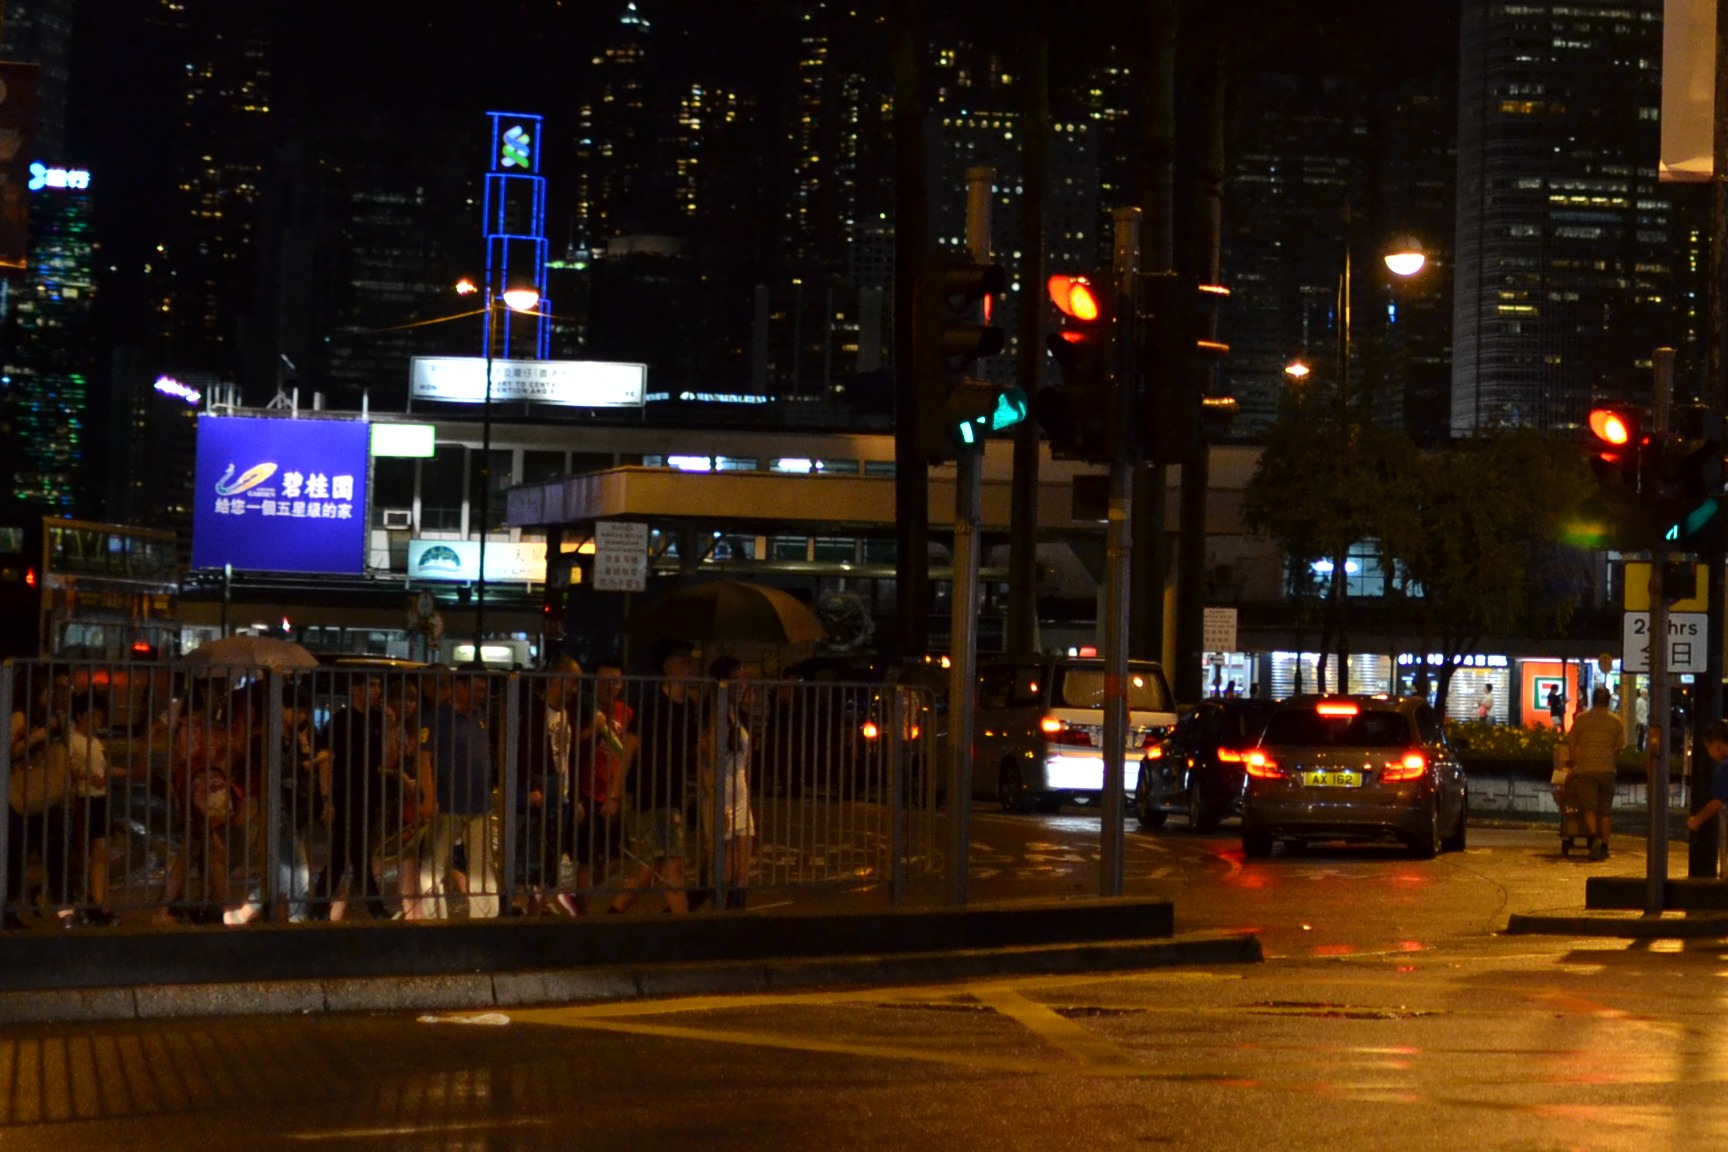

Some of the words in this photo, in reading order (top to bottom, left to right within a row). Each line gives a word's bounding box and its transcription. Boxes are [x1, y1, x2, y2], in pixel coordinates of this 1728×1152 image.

[1667, 619, 1698, 636] hrs
[1312, 774, 1328, 785] AX
[1333, 774, 1353, 785] 162
